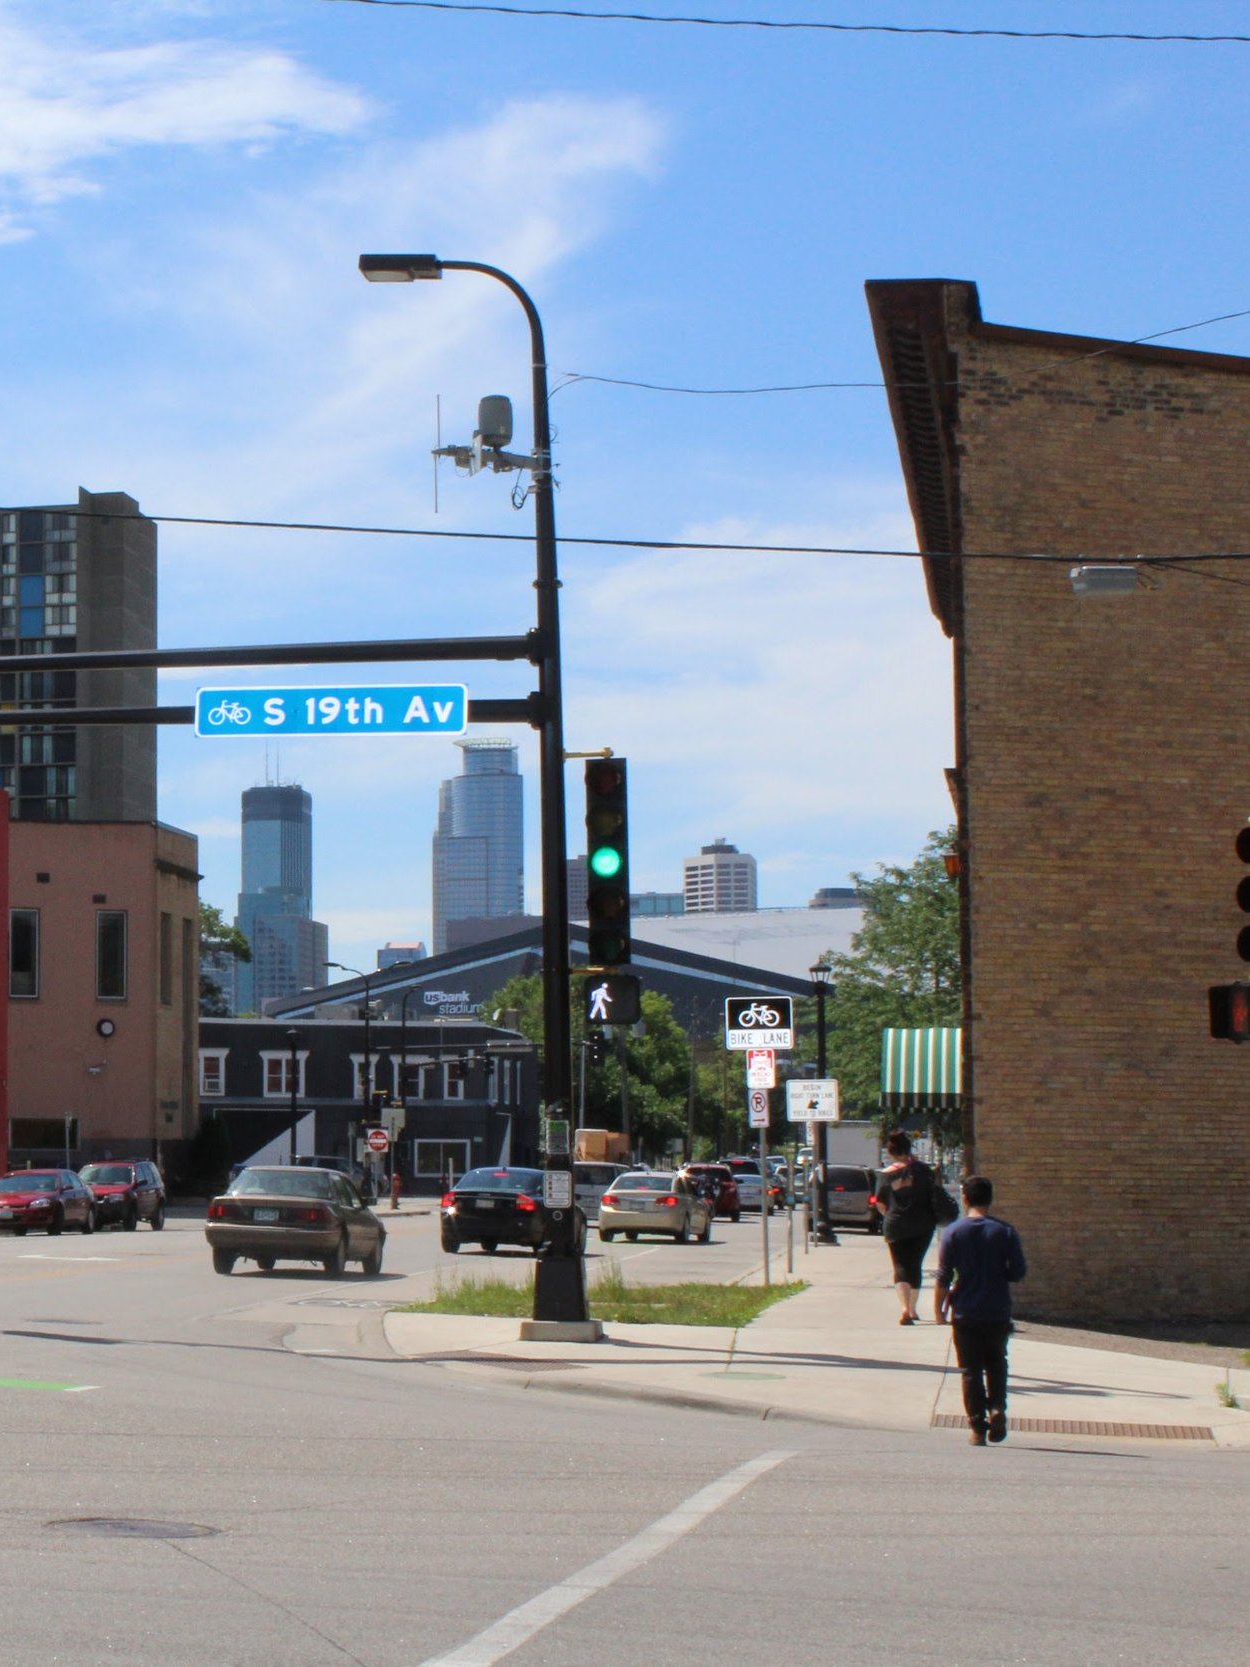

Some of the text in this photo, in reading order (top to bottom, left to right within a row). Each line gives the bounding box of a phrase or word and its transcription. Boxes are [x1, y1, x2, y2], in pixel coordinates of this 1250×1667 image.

[263, 695, 454, 726] S 19th Av
[439, 1002, 483, 1014] stadium
[730, 1032, 790, 1045] BIKE LANE
